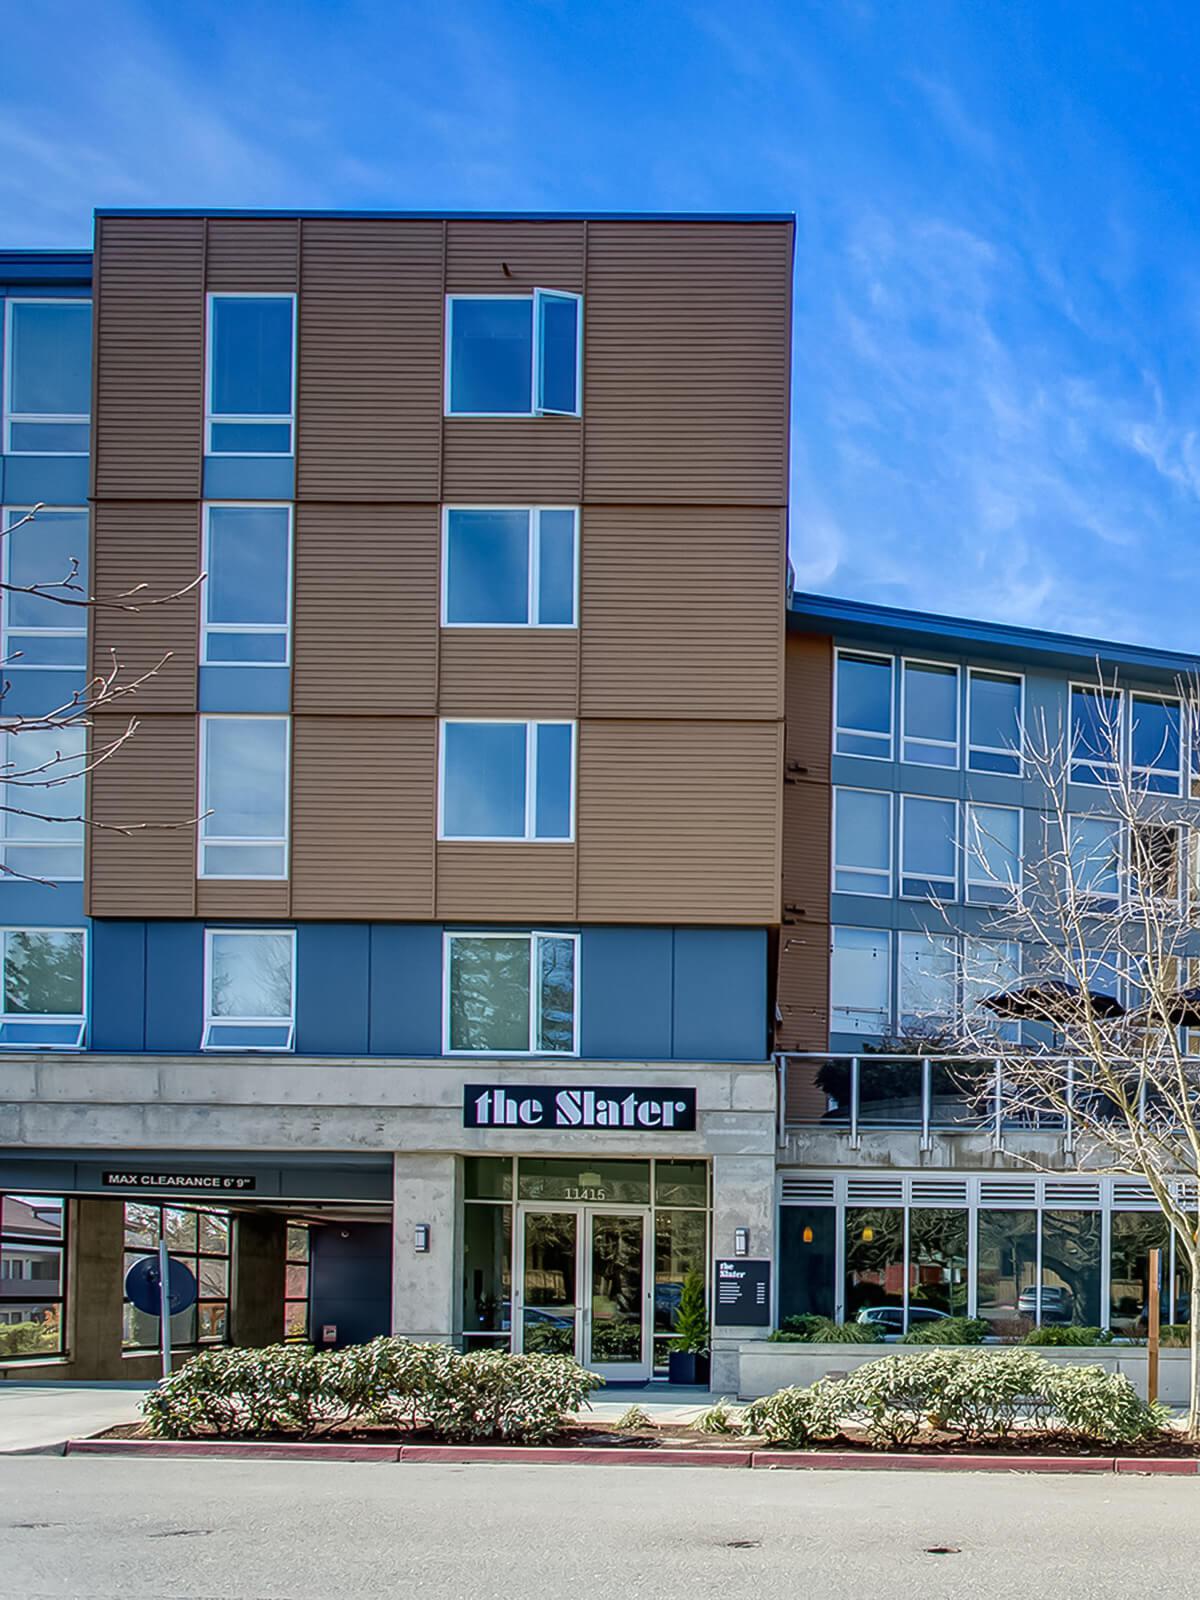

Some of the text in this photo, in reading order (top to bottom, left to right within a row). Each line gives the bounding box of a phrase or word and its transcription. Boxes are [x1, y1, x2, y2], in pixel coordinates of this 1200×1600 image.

[474, 1089, 687, 1126] the Slater
[108, 1174, 137, 1184] MAX
[140, 1175, 220, 1187] CLEARANCE
[564, 1188, 605, 1201] 11415
